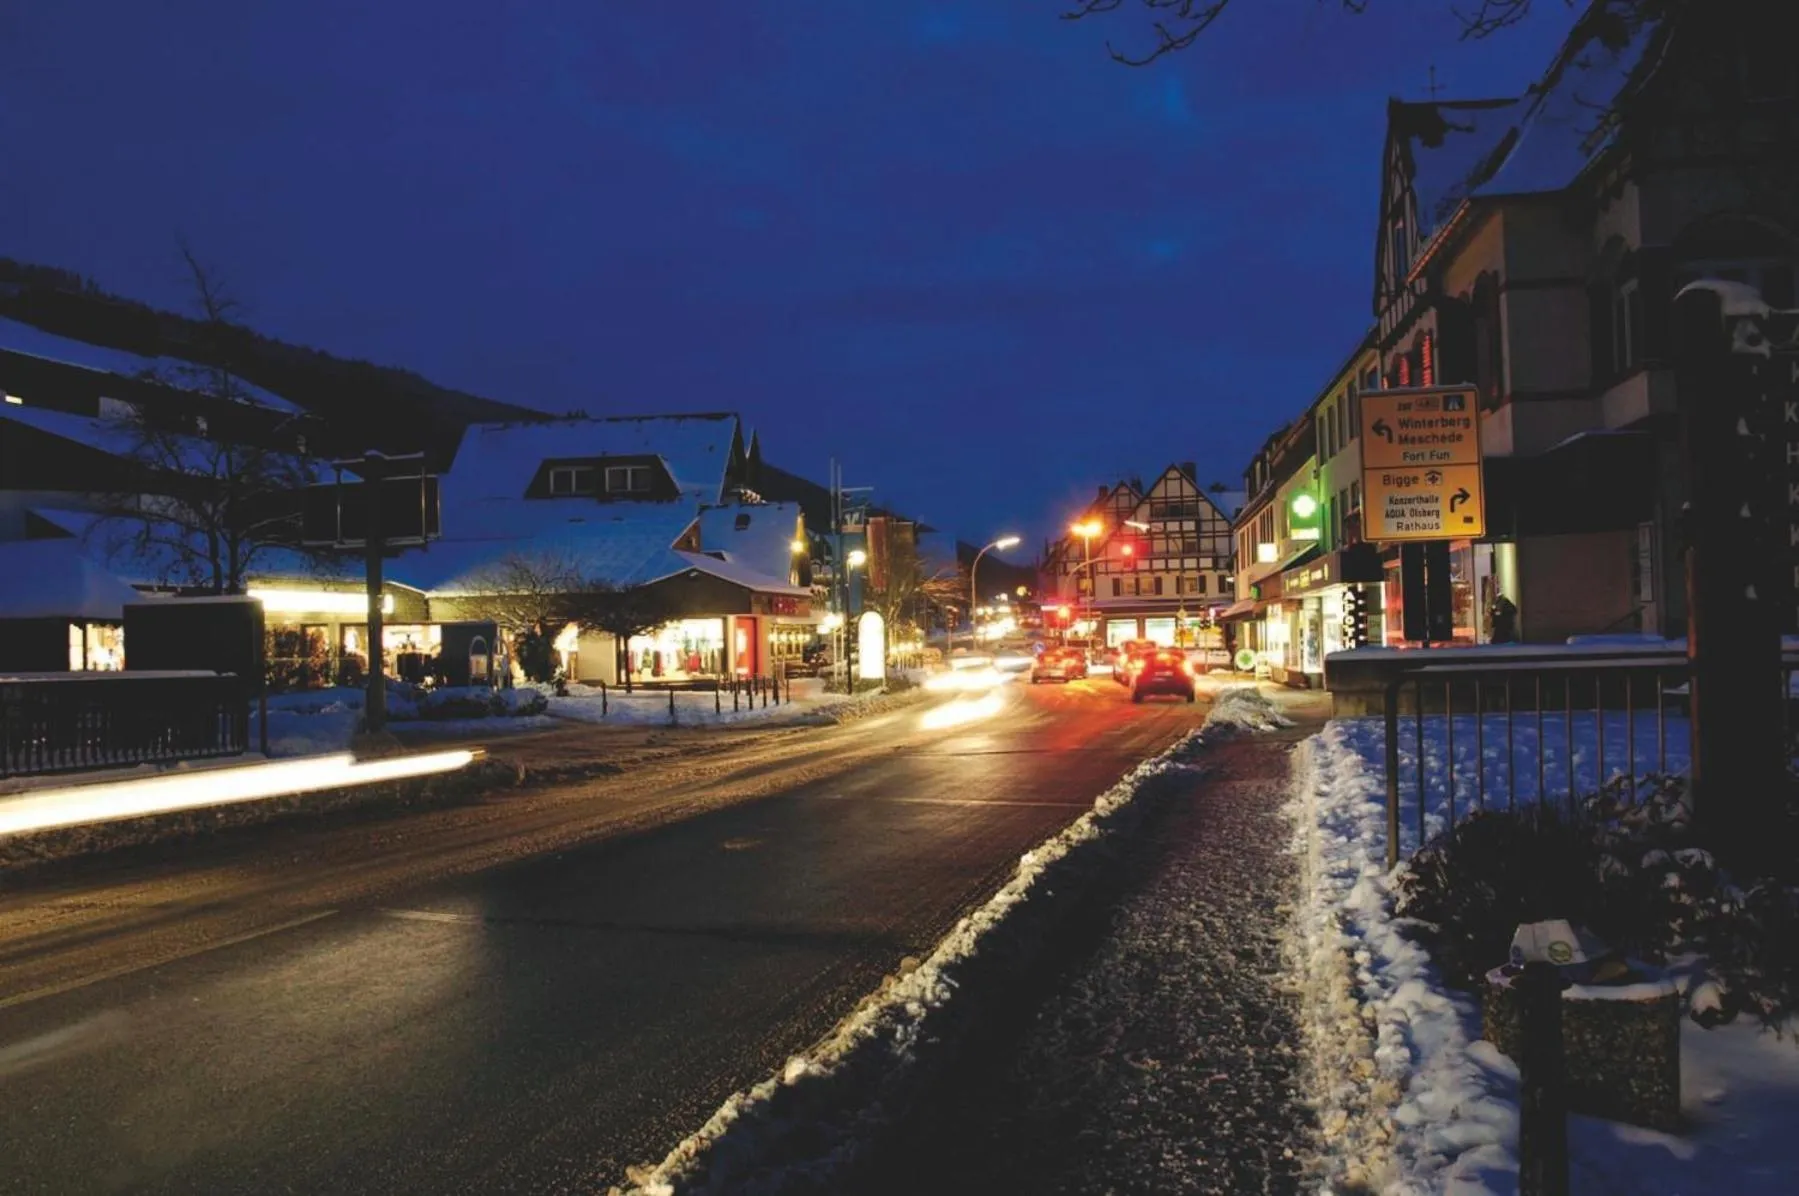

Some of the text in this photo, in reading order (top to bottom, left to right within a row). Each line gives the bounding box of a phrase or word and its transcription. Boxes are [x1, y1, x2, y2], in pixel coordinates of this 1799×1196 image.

[1398, 416, 1471, 430] Winterberg
[1398, 432, 1464, 445] Meschede
[1402, 449, 1450, 461] Fort Fun
[1383, 474, 1419, 487] Bigge
[1388, 494, 1440, 505] Konzerthalle
[1385, 507, 1440, 519] AQUA Olsberg
[1396, 521, 1441, 531] Rathaus
